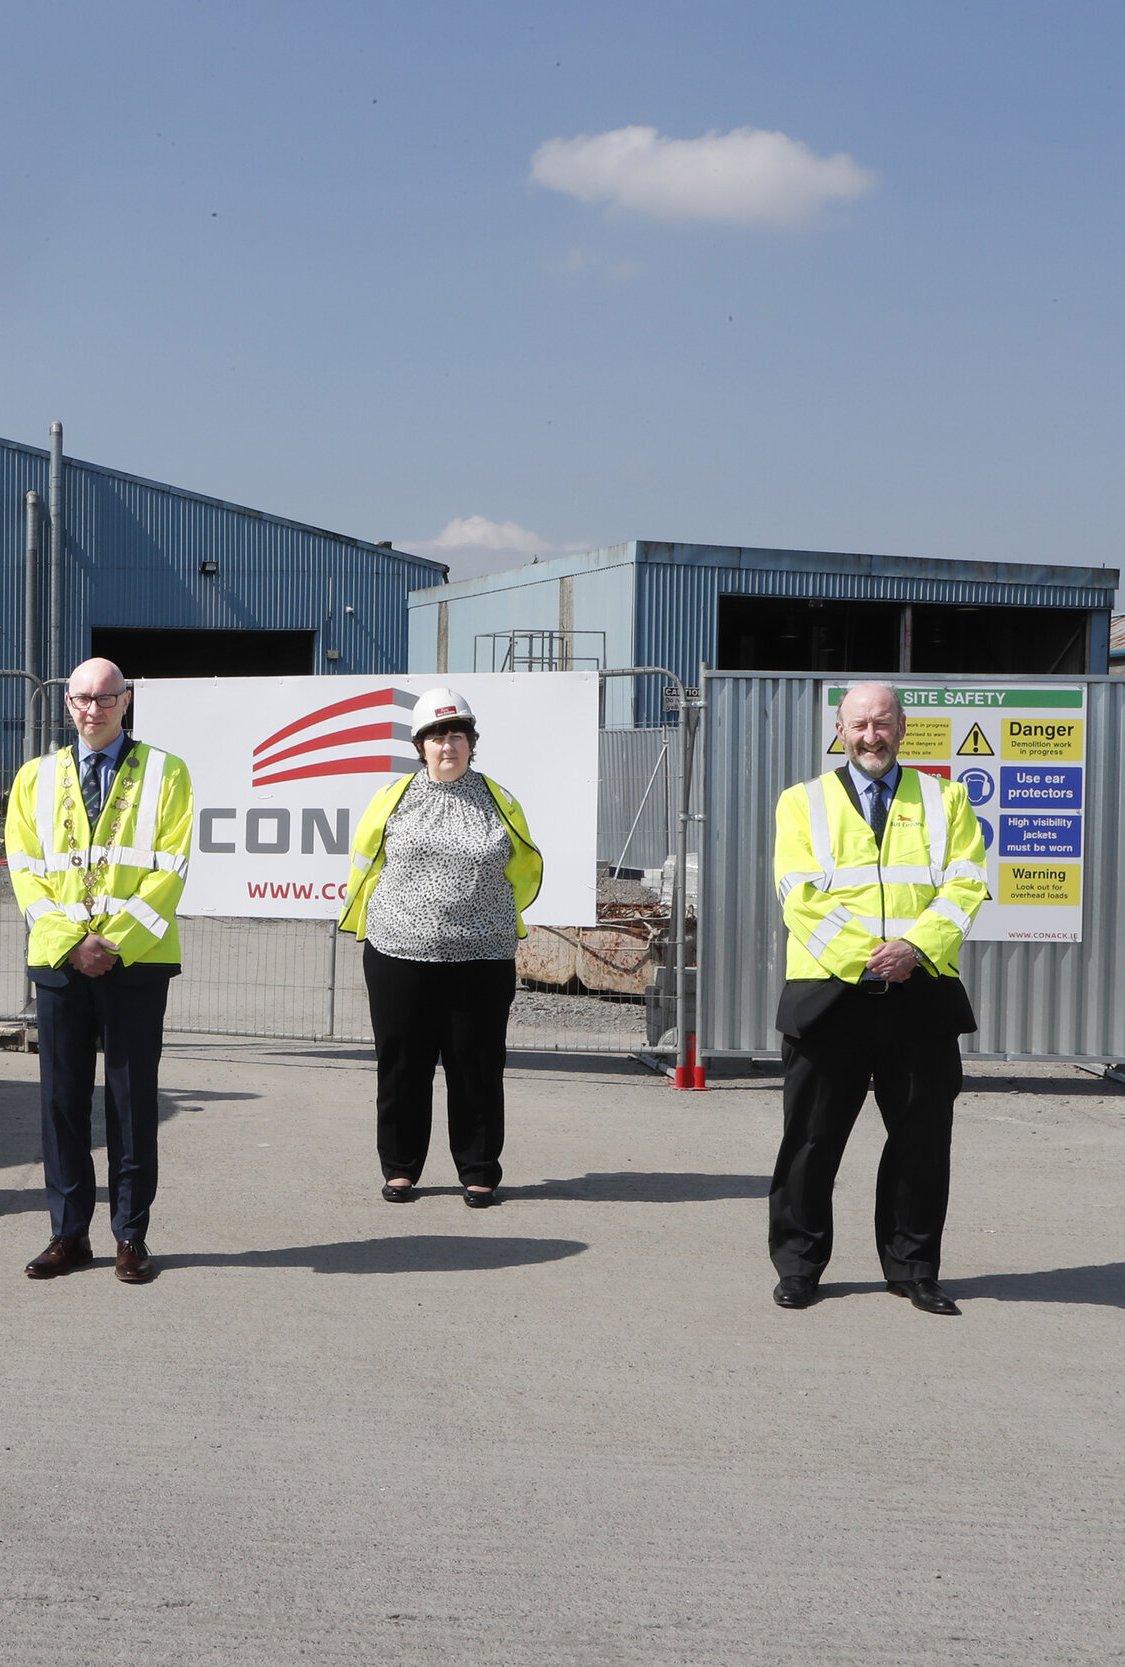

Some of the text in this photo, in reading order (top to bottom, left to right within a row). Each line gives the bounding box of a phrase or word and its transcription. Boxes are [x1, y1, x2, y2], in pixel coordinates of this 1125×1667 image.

[903, 691, 1007, 705] SITE SAFETY
[1009, 721, 1075, 741] Danger
[1011, 740, 1052, 749] Demolition
[1016, 772, 1066, 784] Use ear
[1008, 788, 1074, 801] protectors
[1008, 817, 1073, 829] High visibility
[199, 808, 350, 855] CON
[1023, 830, 1058, 841] jackets
[1007, 843, 1073, 852] must be worn
[1012, 868, 1067, 882] Warning
